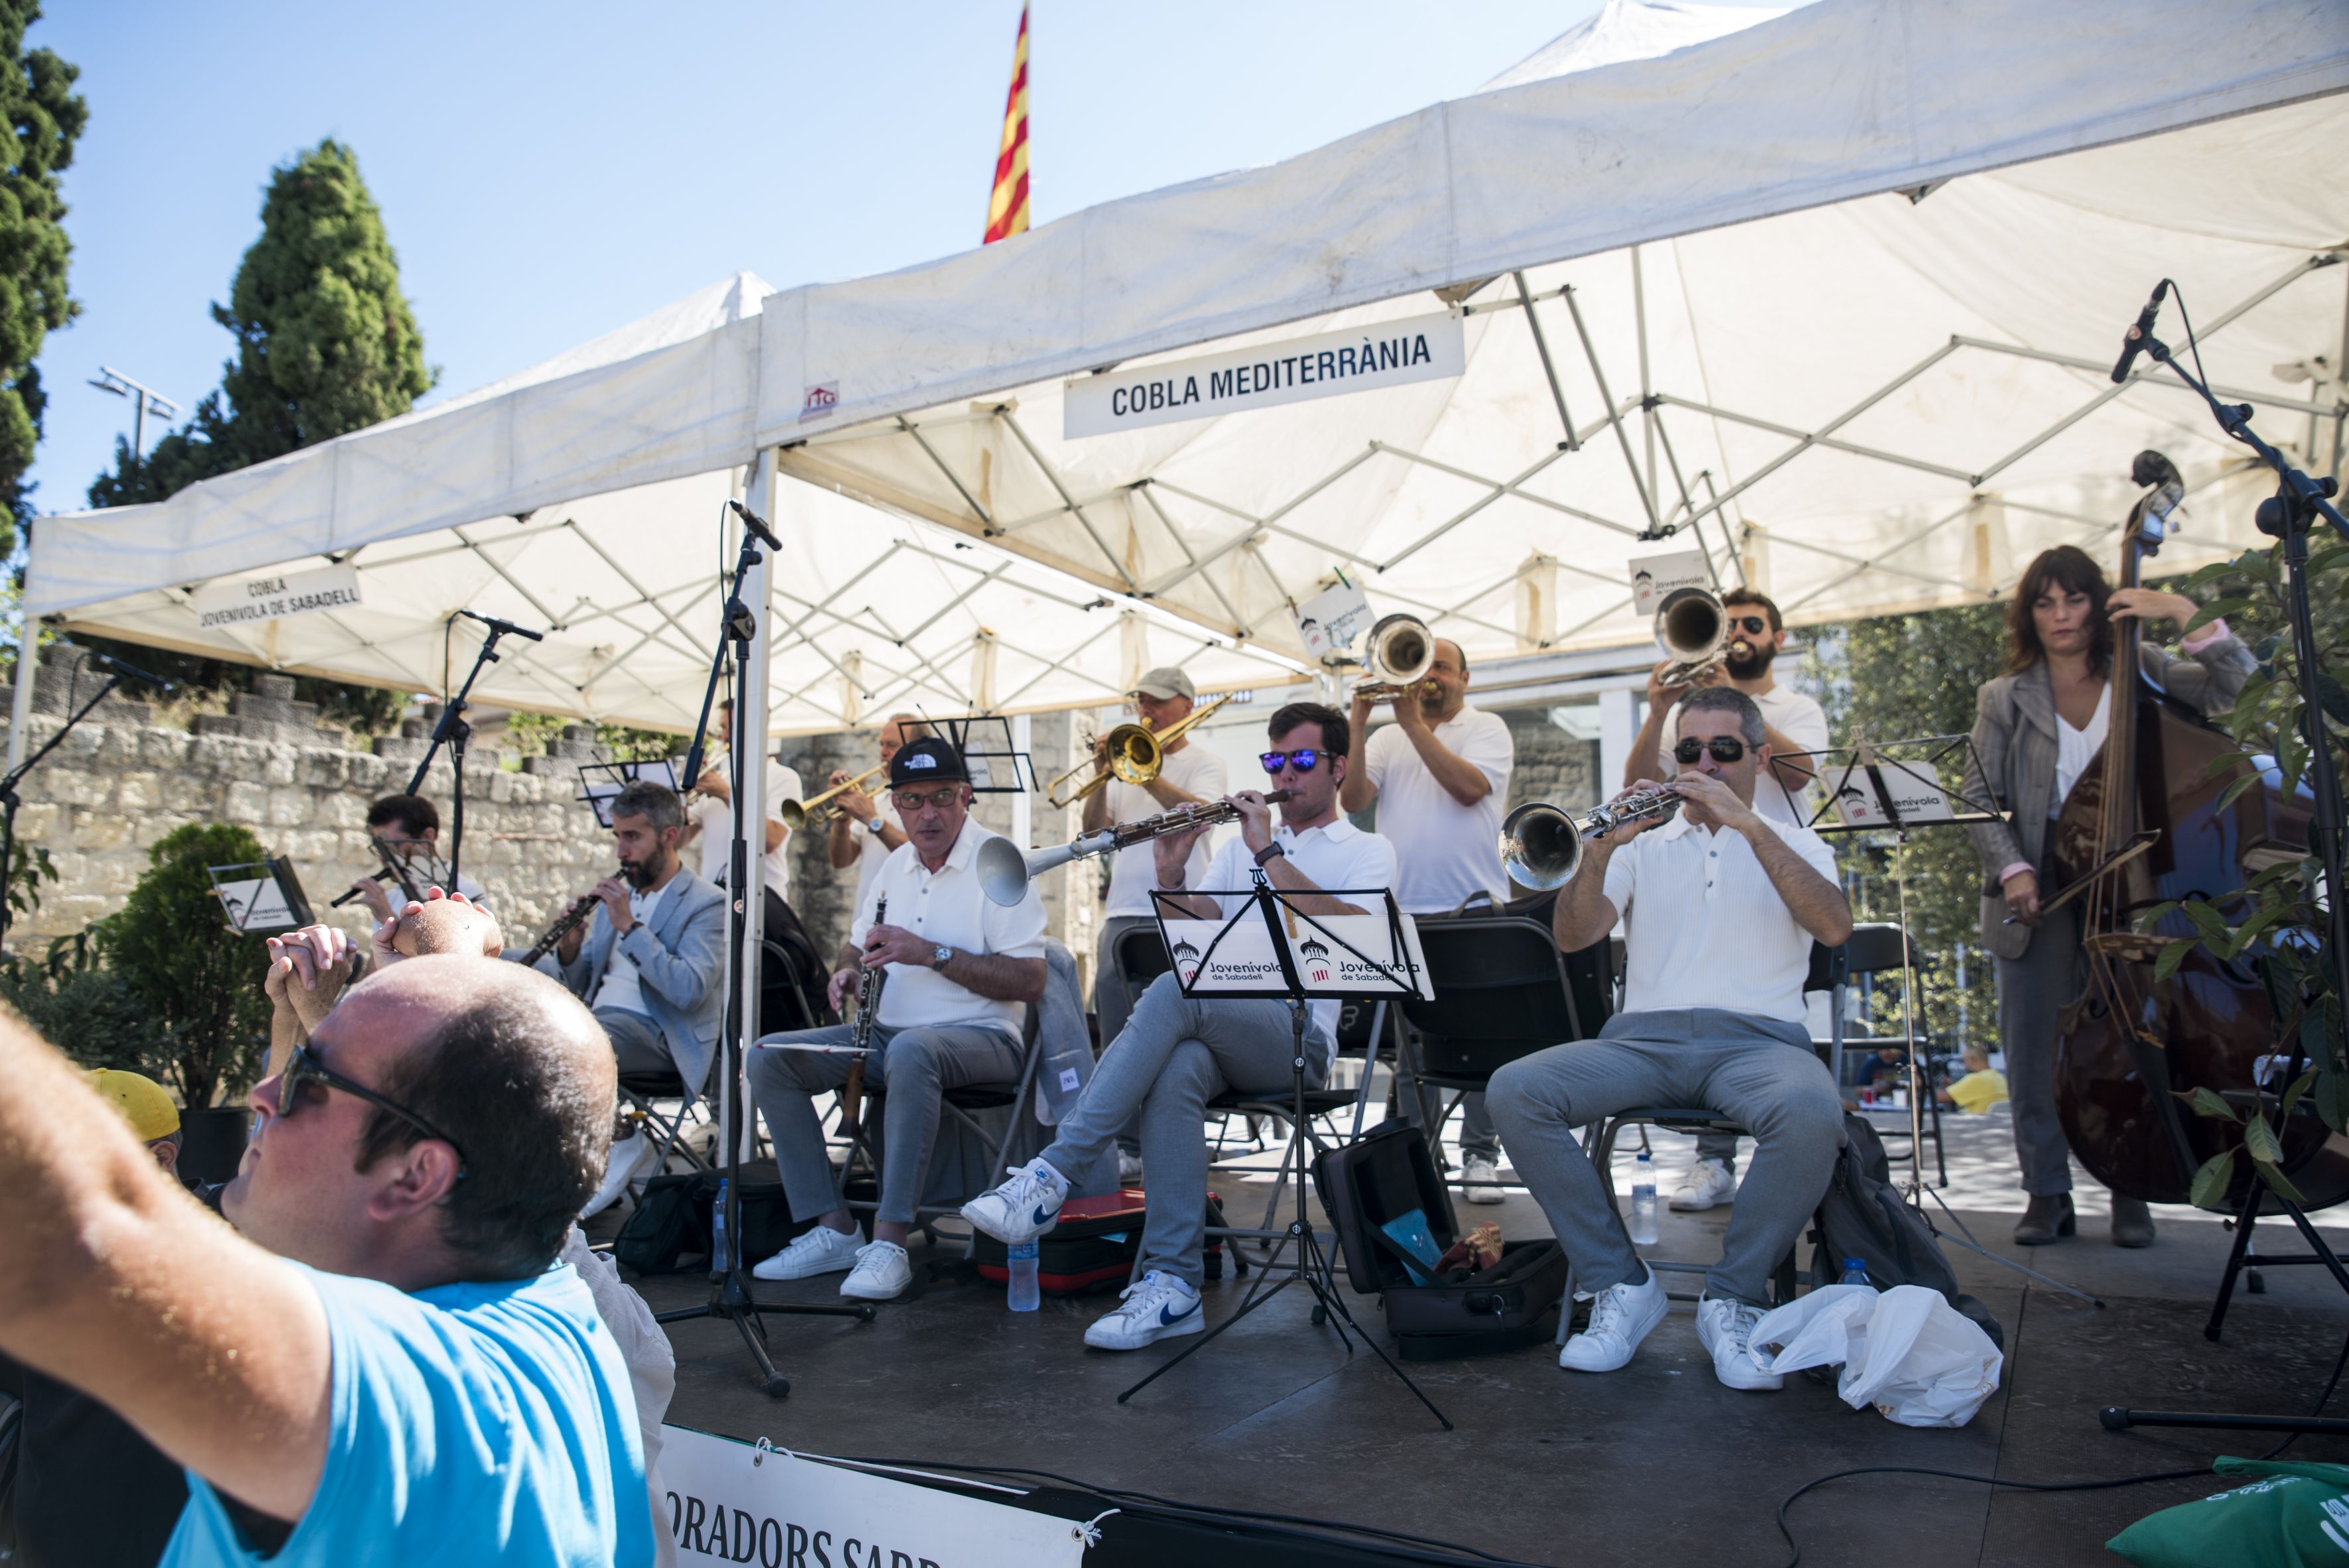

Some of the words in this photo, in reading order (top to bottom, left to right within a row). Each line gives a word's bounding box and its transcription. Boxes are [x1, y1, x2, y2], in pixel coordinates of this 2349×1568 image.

[1111, 375, 1201, 416] COBLA
[1210, 333, 1432, 400] MEDITERRÀNIA
[247, 577, 288, 597] COBLA
[269, 599, 286, 615] DE
[288, 587, 360, 613] SABADELL
[1874, 796, 1940, 809] Jenívola
[1339, 959, 1420, 973] Jovenívoa
